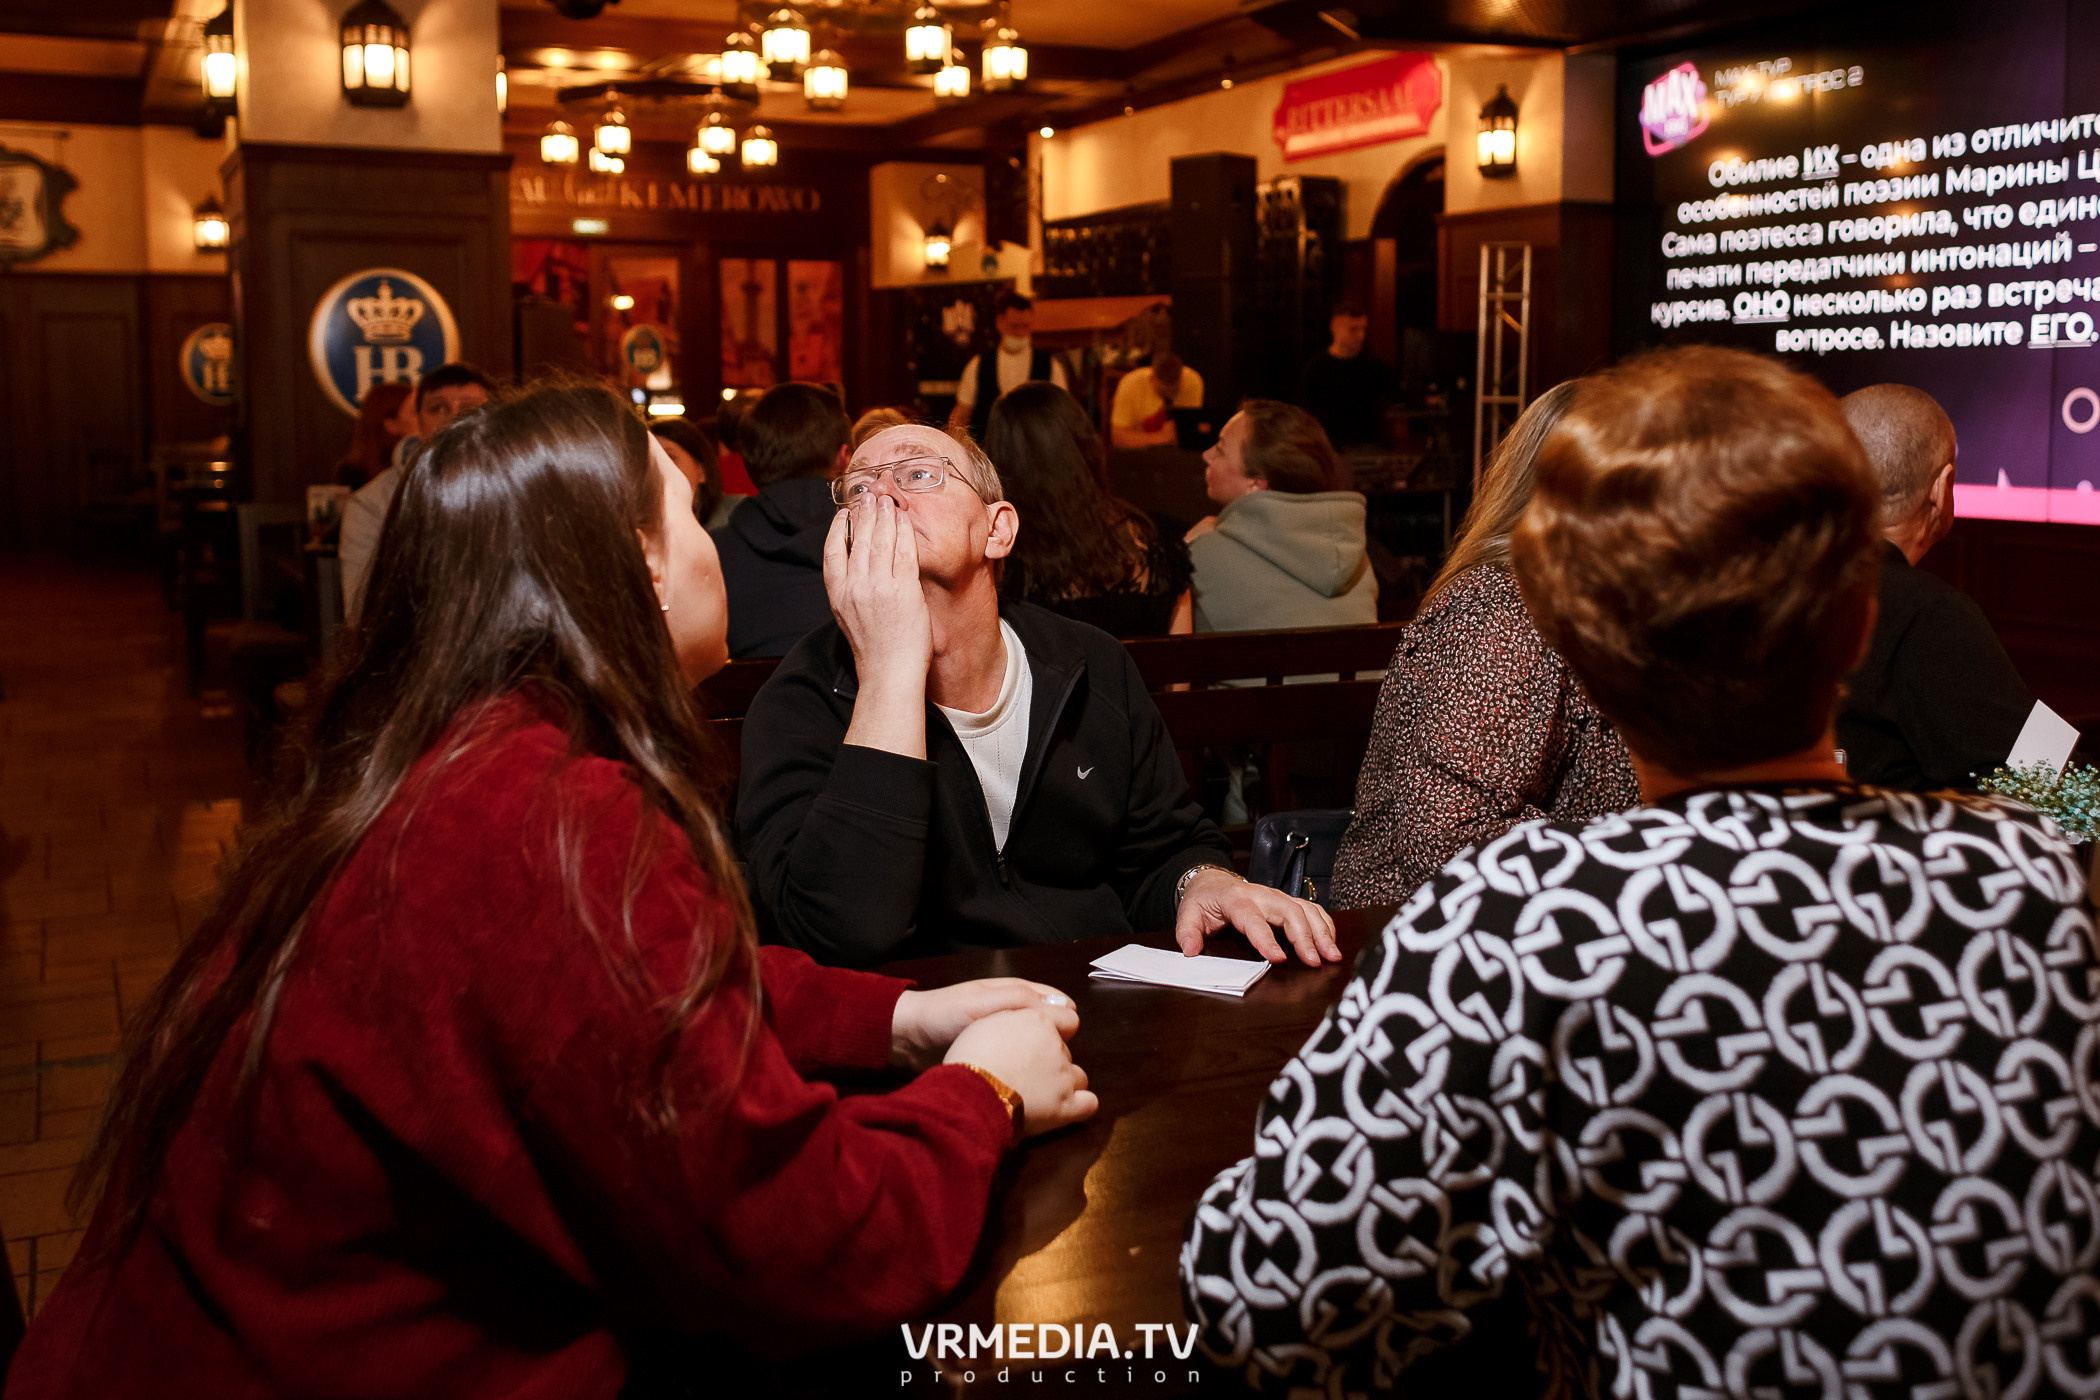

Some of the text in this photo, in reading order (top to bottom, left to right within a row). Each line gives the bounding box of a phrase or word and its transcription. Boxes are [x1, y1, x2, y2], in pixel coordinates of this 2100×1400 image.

[1708, 155, 1800, 188] Обилие
[1802, 143, 1841, 180] ИХ
[1860, 137, 1927, 170] одна
[1932, 132, 1967, 159] из
[1677, 179, 1840, 225] особенностей
[1844, 172, 1940, 207] поэзии
[1945, 156, 2070, 197] Марины
[1661, 194, 2100, 259] Сама поэтесса говорила, что един
[1666, 263, 1743, 291] печати
[1745, 251, 1906, 289] передатчики
[1911, 230, 2073, 274] интонаций
[1651, 299, 1731, 329] курсив.
[1732, 289, 1791, 324] ОНО
[1793, 287, 1928, 317] несколько
[1932, 284, 1982, 317] раз
[1775, 311, 2100, 356] вопросе. Назовите ЕГО.
